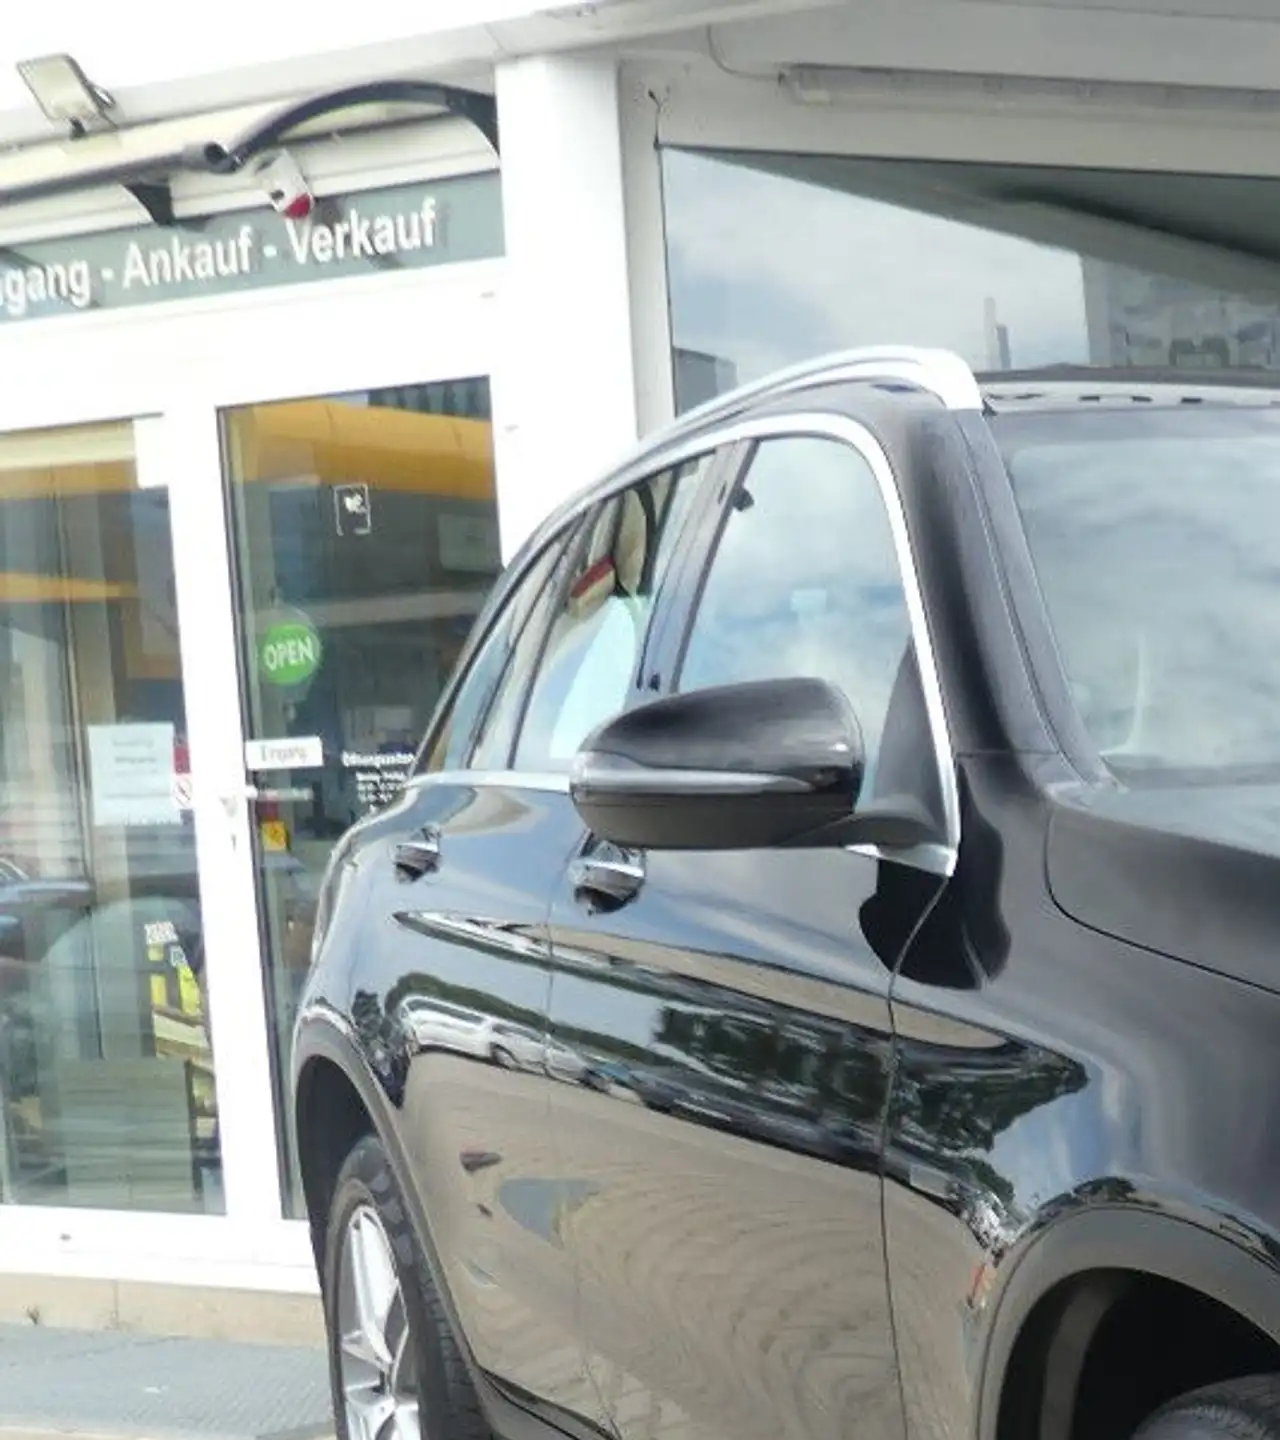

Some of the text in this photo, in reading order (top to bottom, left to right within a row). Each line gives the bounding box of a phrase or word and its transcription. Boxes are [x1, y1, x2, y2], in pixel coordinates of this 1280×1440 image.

[0, 259, 91, 316] gang
[122, 225, 252, 289] Ankauf
[285, 197, 436, 264] Verkauf
[264, 635, 315, 671] OPEN
